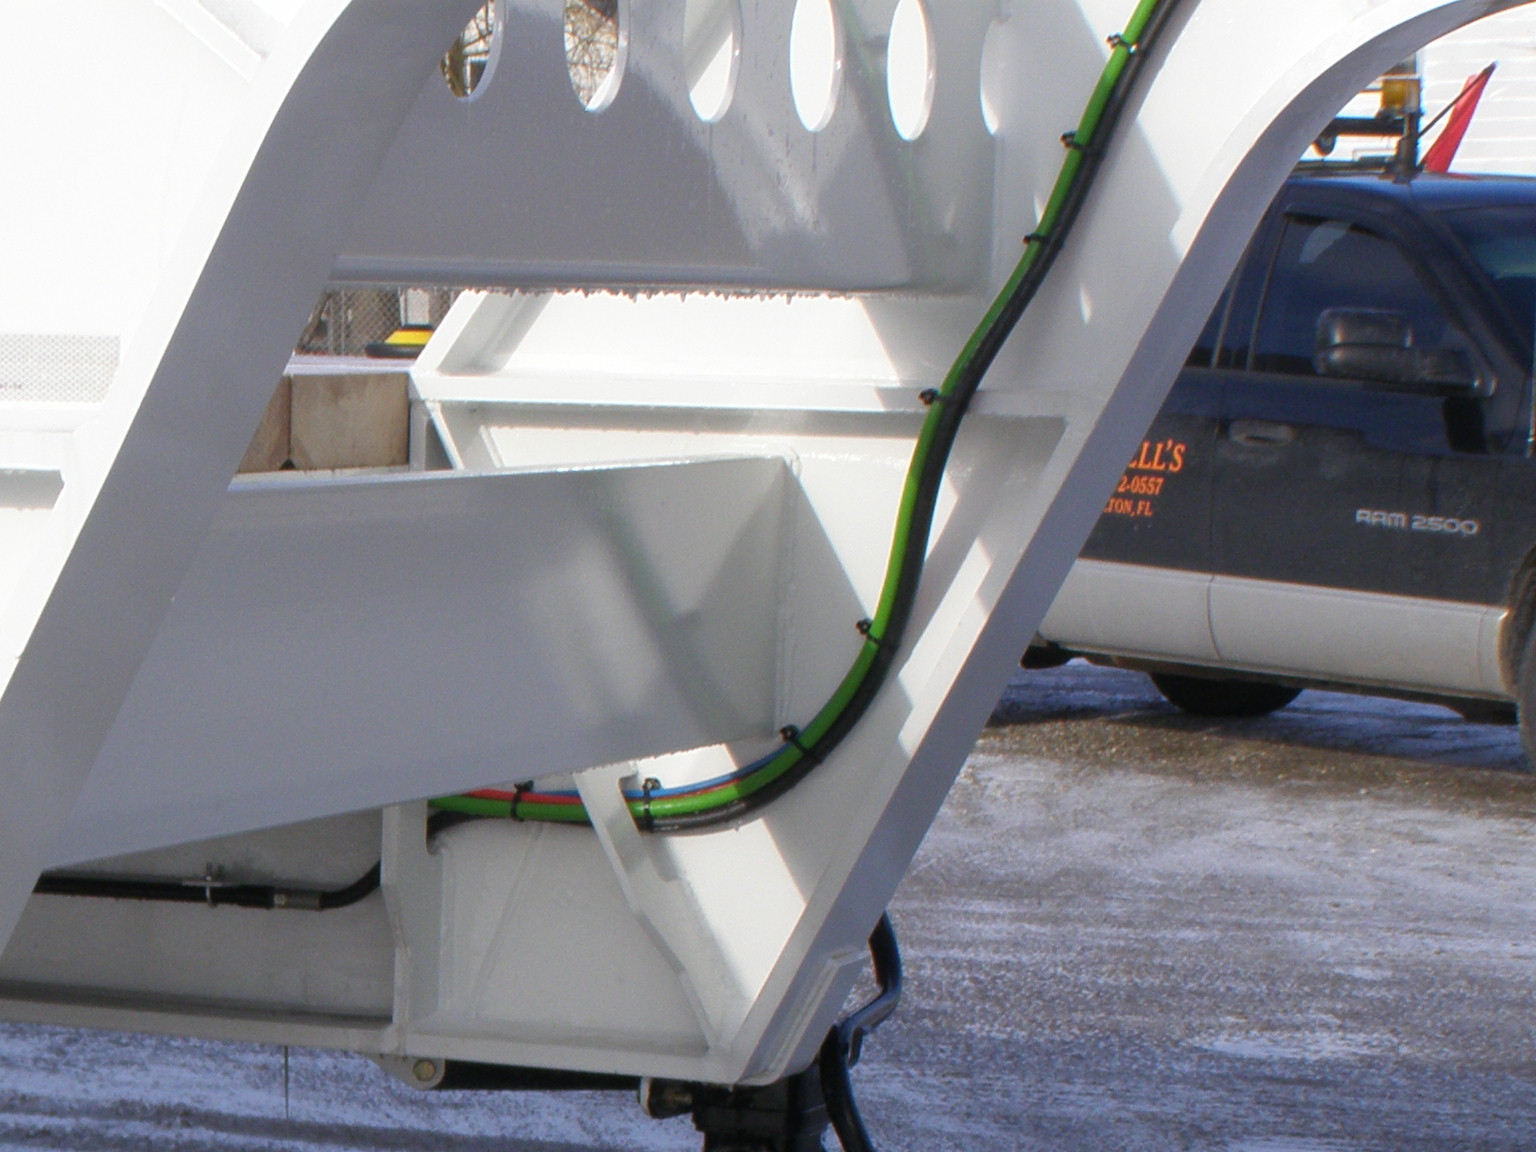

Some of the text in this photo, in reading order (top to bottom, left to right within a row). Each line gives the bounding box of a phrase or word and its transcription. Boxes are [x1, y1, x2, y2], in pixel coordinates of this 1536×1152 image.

[1128, 437, 1187, 472] LL'S
[1104, 497, 1135, 517] TON,
[1355, 508, 1479, 535] RAM 2500
